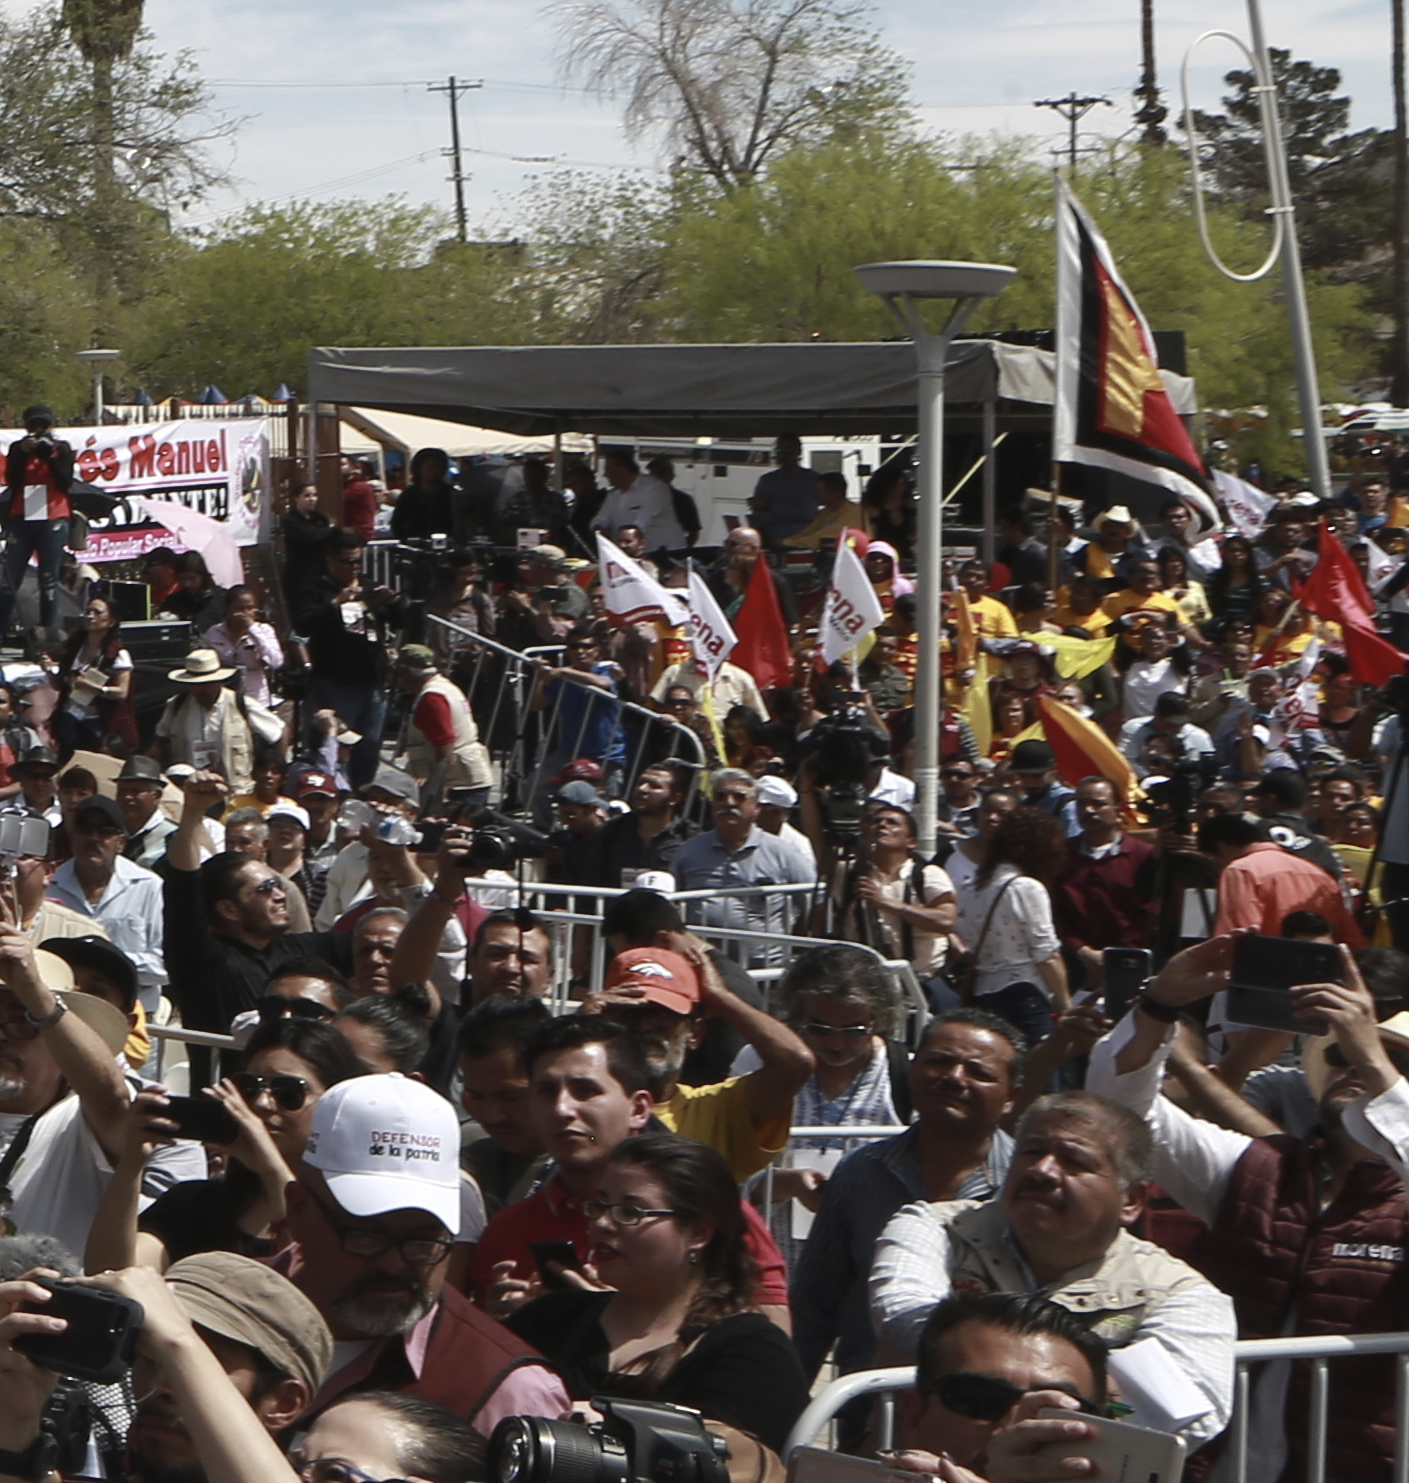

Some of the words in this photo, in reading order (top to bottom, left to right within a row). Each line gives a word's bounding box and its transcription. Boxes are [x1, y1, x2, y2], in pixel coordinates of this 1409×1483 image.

[128, 428, 228, 480] Manuel
[372, 1131, 441, 1148] DEFENSOR
[369, 1144, 385, 1157] de
[389, 1144, 402, 1158] la
